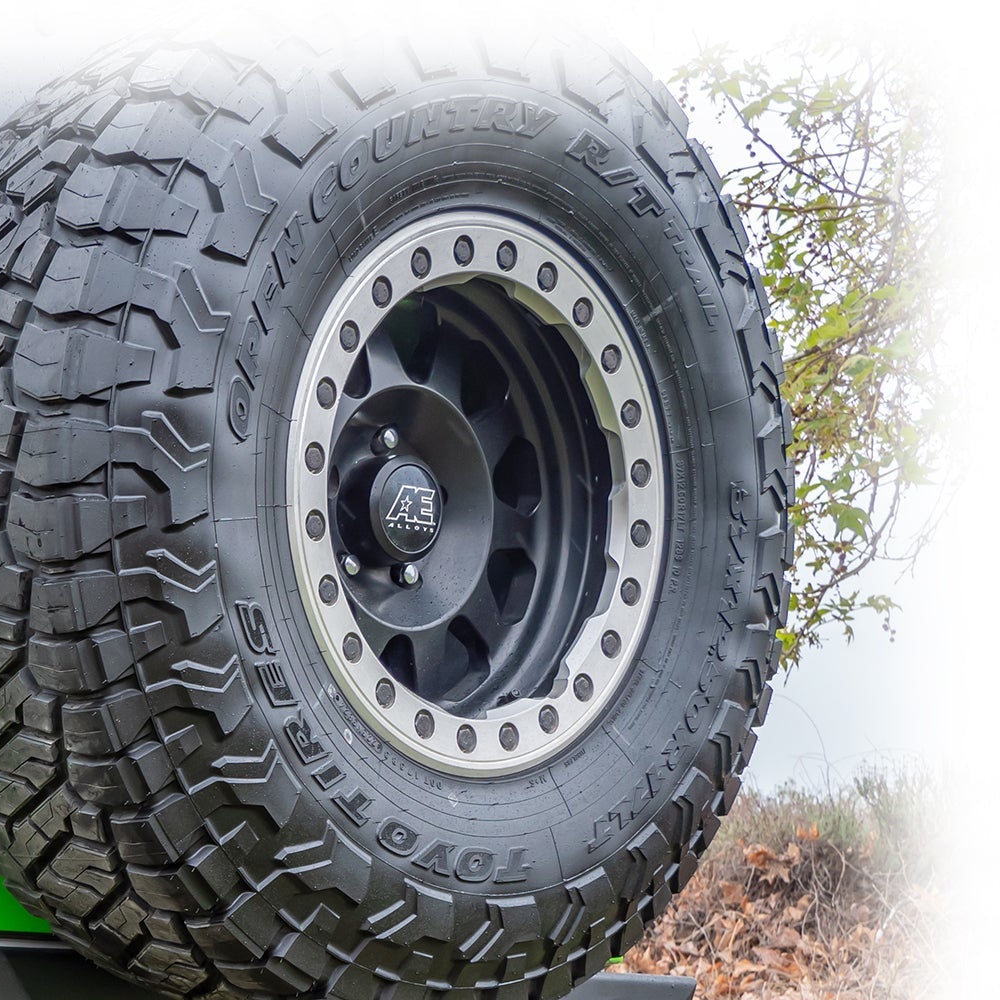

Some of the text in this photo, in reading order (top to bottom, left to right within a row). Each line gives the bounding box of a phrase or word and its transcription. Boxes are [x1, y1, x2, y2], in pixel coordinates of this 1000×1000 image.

[227, 210, 306, 441] OPEN
[309, 94, 560, 223] COUNTRY
[565, 127, 666, 218] R/T
[663, 218, 717, 328] TRAIL
[388, 522, 434, 533] ALLOYS
[234, 599, 373, 828] TIRES
[376, 814, 530, 883] TOYO
